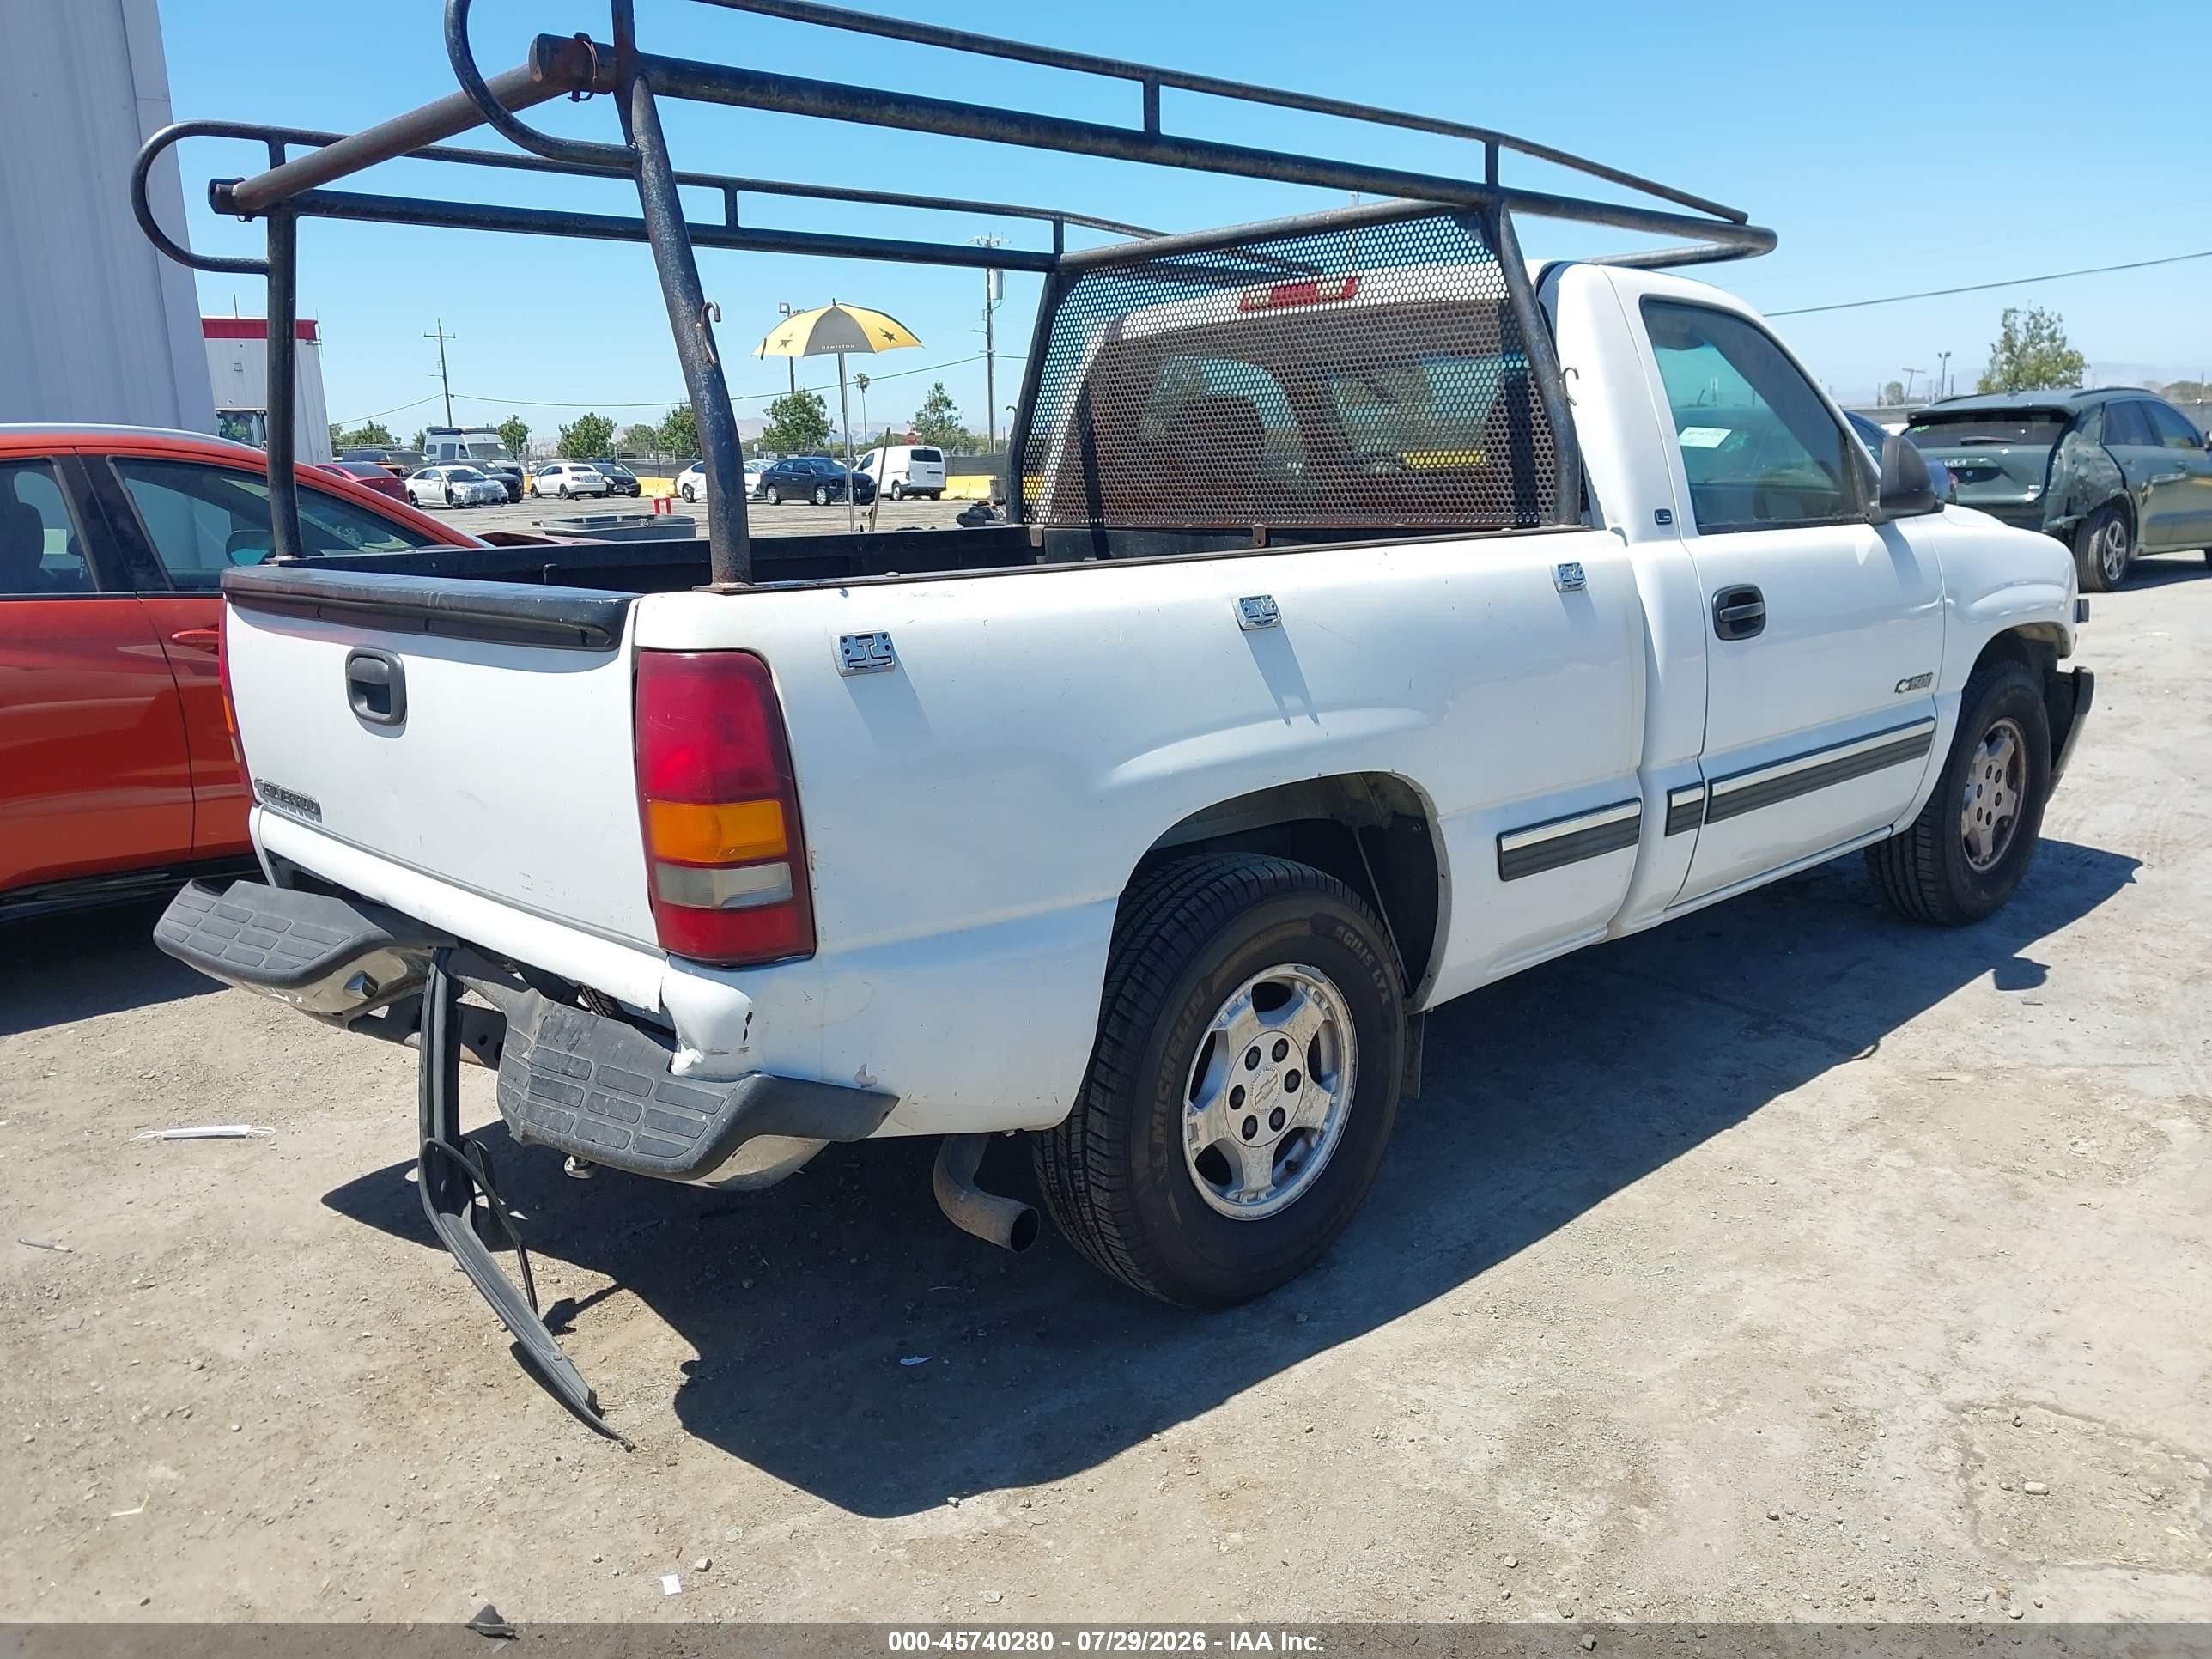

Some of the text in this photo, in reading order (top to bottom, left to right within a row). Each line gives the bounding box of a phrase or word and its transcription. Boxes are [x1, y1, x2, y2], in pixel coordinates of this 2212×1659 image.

[1334, 925, 1389, 1004] AGILIS LTX
[1152, 984, 1207, 1143] MICHELIN
